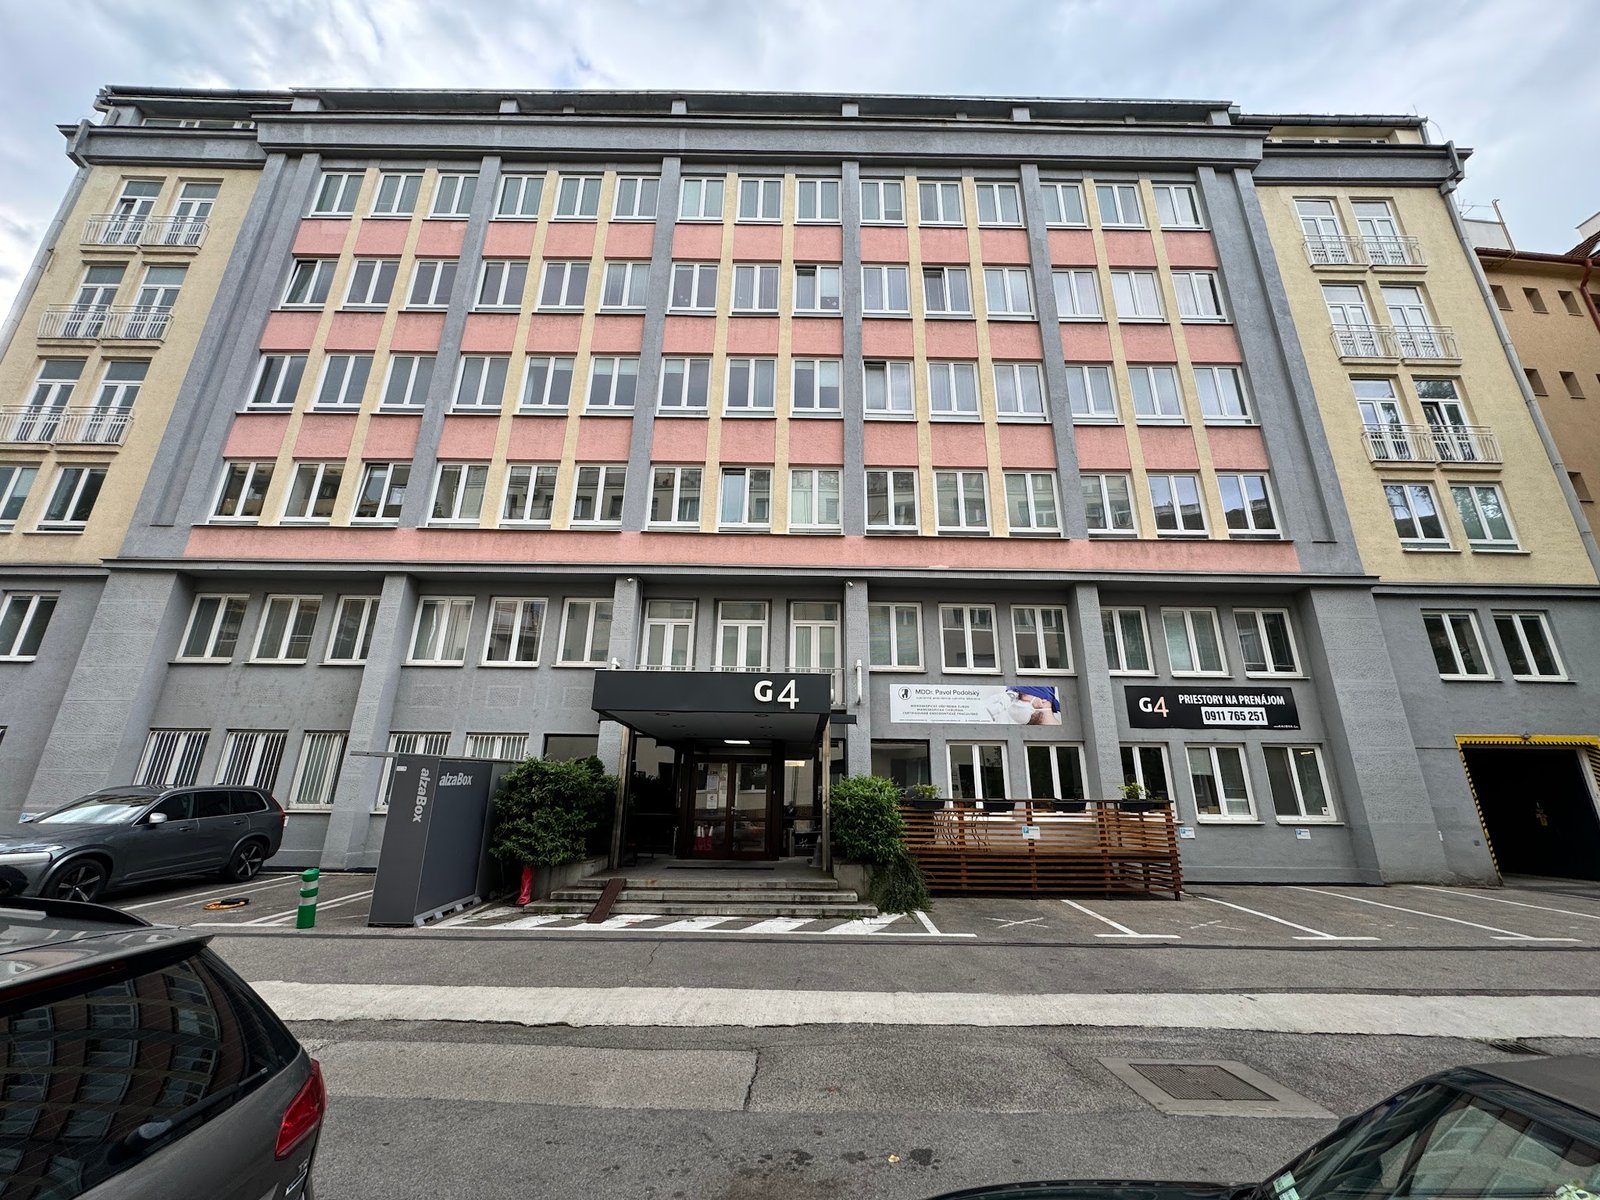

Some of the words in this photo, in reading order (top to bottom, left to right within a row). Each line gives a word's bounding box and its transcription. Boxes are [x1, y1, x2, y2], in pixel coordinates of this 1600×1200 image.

[753, 679, 800, 710] G4
[1178, 694, 1223, 705] PRIESTORY
[1225, 695, 1238, 705] NA
[1239, 693, 1285, 706] PRENÁJOM
[1138, 696, 1169, 718] G4
[1204, 710, 1226, 721] 0911
[1228, 711, 1247, 721] 765
[1248, 711, 1265, 722] 251
[439, 772, 473, 786] alzaBox
[412, 767, 431, 823] alzaBox
